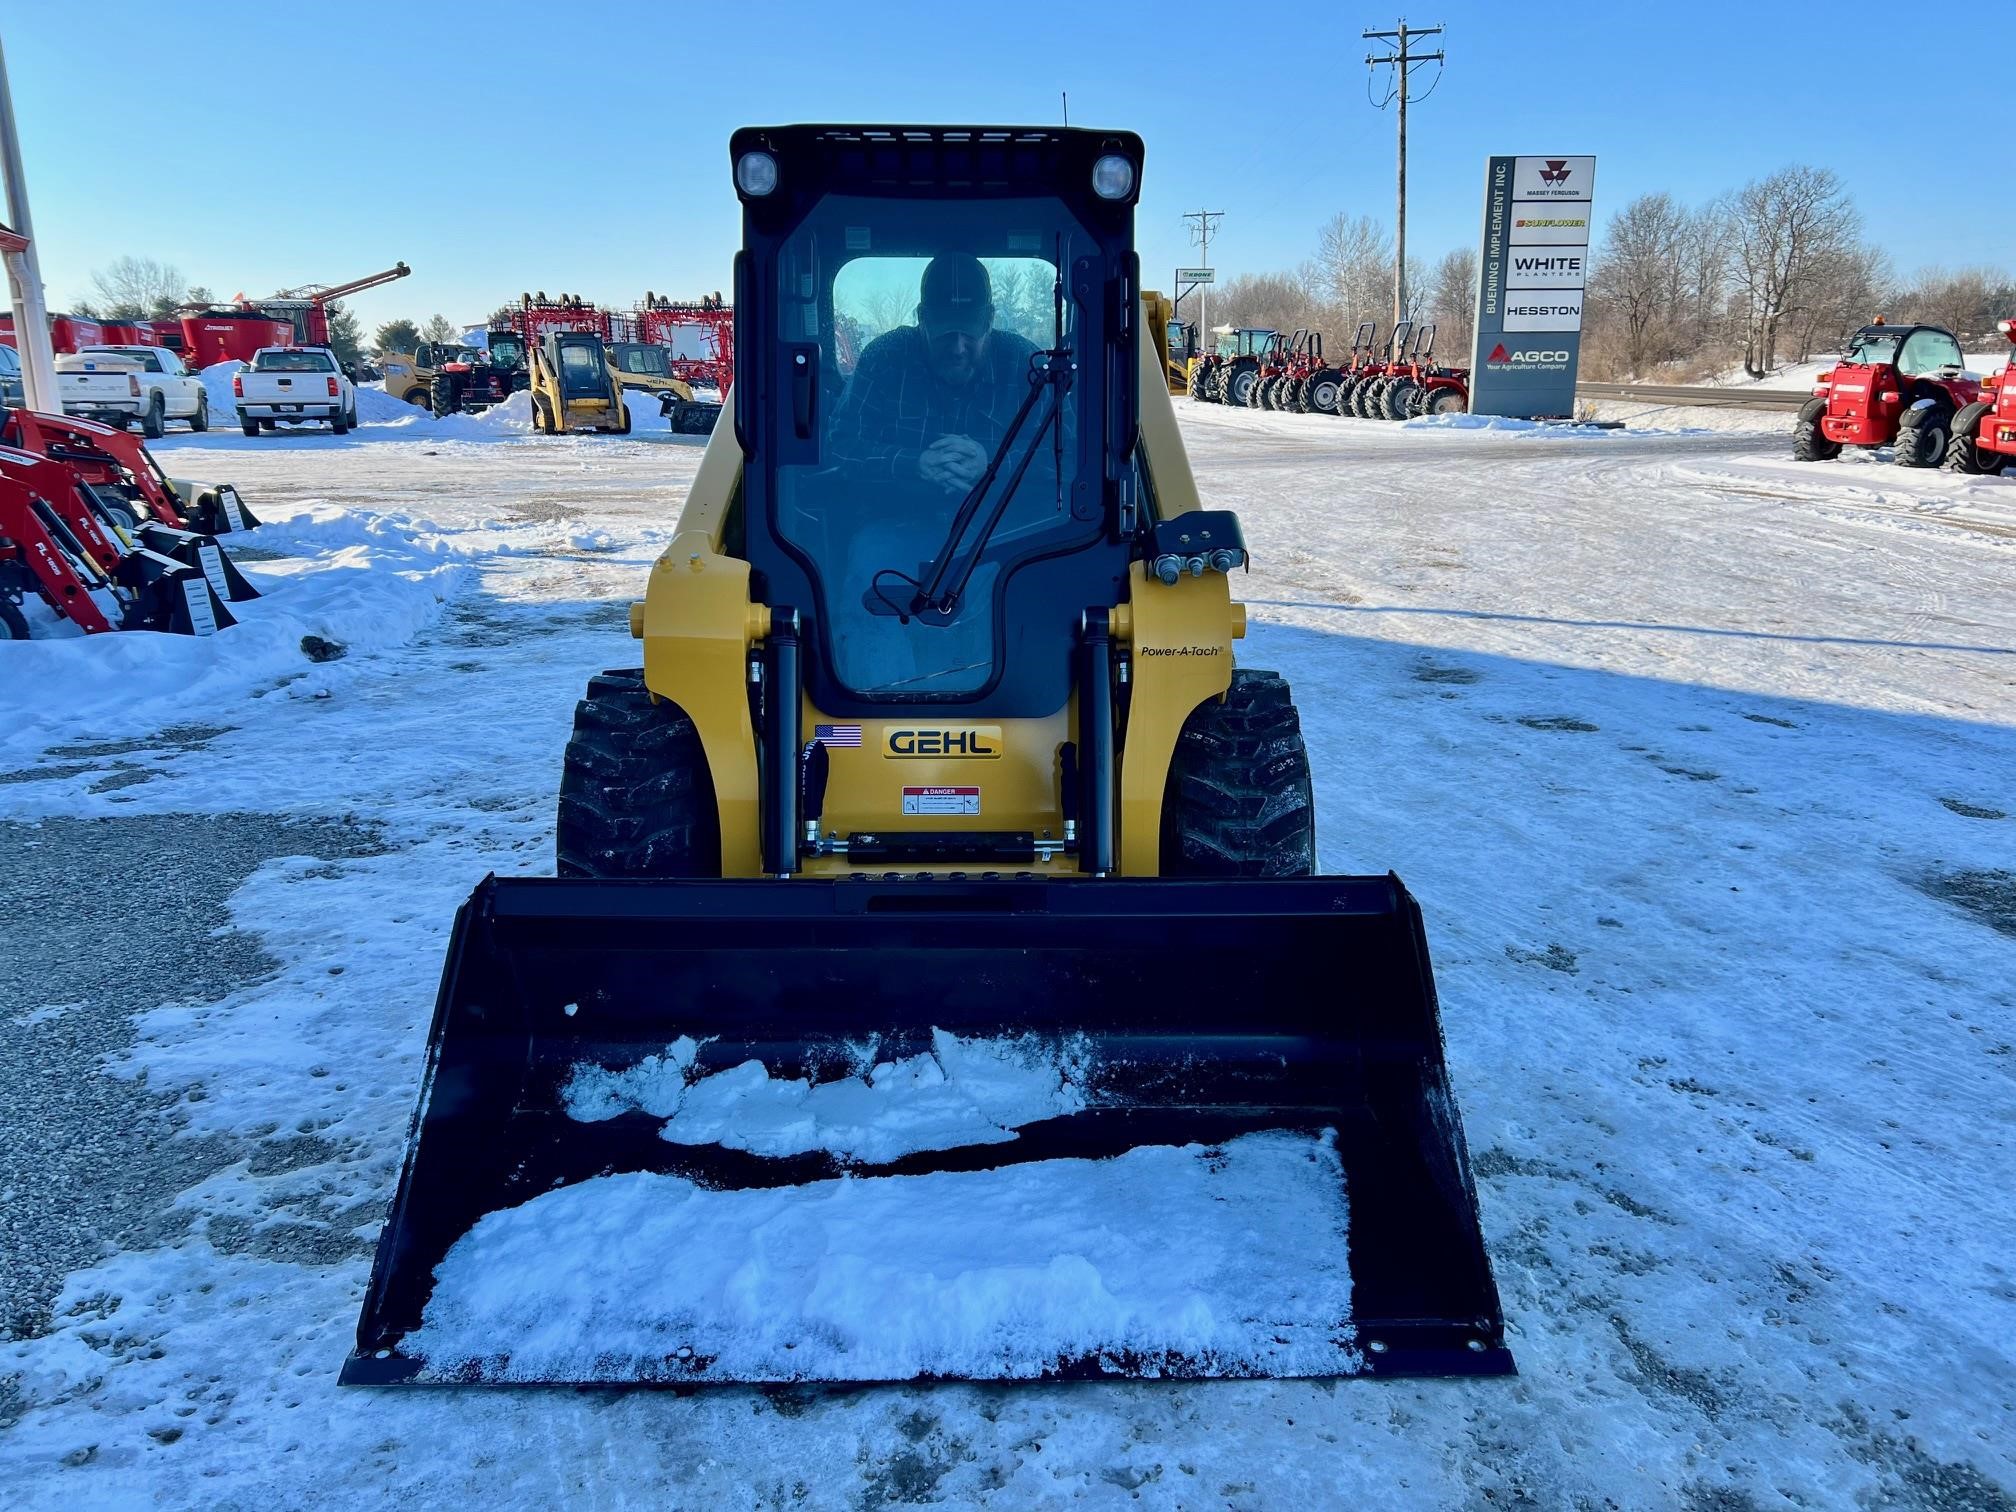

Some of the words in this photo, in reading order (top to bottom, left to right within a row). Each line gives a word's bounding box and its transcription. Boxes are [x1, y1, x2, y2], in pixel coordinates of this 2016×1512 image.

[1495, 163, 1507, 187] INC.
[1490, 189, 1504, 258] IMPLEMENT
[1525, 219, 1585, 228] SUNFLOWER
[1514, 257, 1581, 270] WHITE
[1486, 261, 1499, 314] BUENING
[1507, 306, 1580, 316] HESSTON
[1510, 350, 1570, 362] AGCO
[1501, 363, 1536, 371] Agriculture
[1537, 363, 1567, 371] Company
[79, 517, 90, 530] FL
[35, 542, 48, 556] FL
[889, 731, 993, 754] GEHL
